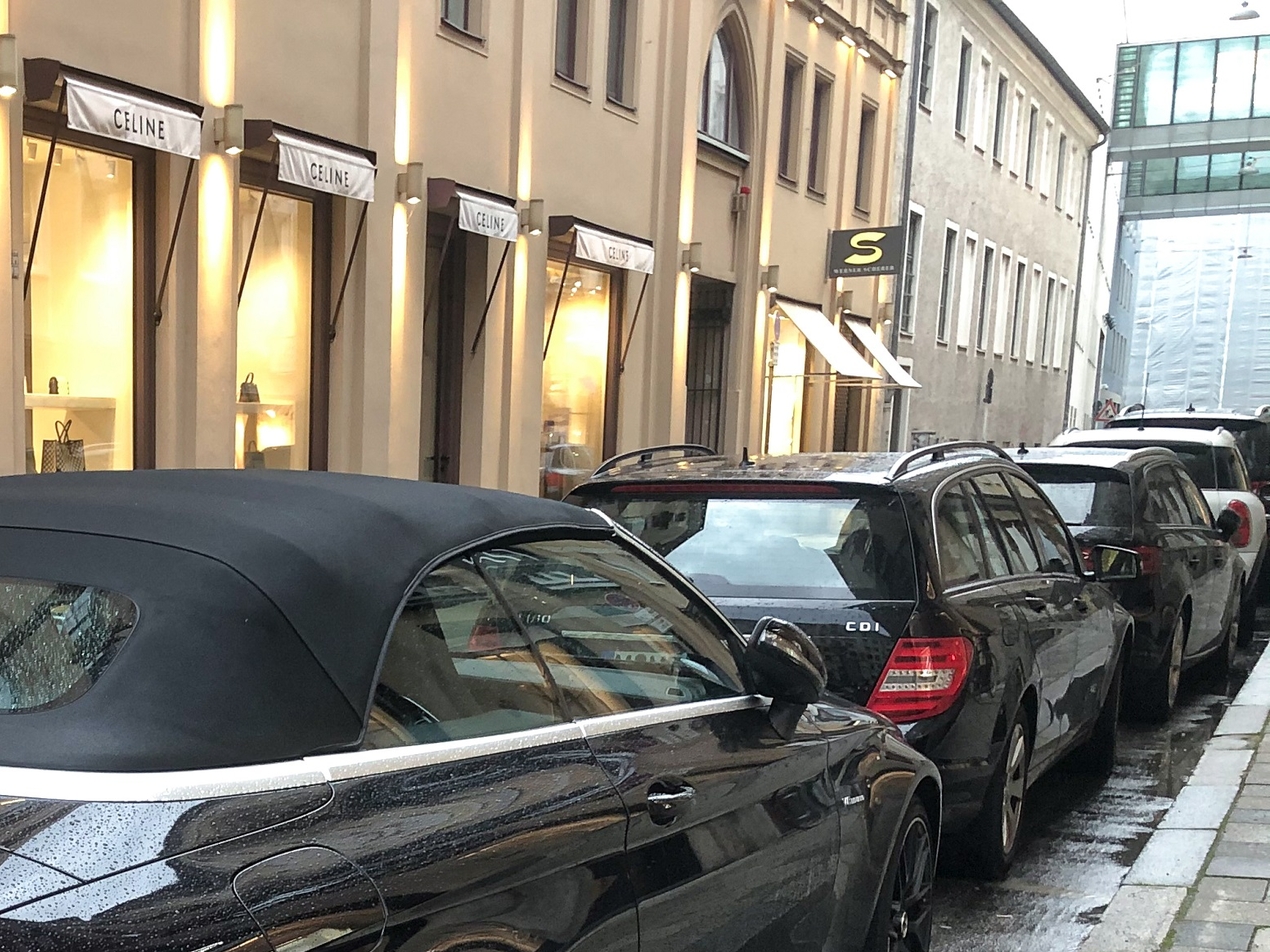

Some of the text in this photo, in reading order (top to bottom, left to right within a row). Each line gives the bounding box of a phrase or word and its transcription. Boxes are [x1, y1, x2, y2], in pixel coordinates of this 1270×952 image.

[113, 108, 165, 140] CELINE
[310, 162, 349, 188] CELINE
[476, 211, 505, 232] CELINE
[608, 246, 629, 263] CELINE
[843, 231, 887, 265] S
[845, 621, 880, 632] CDI
